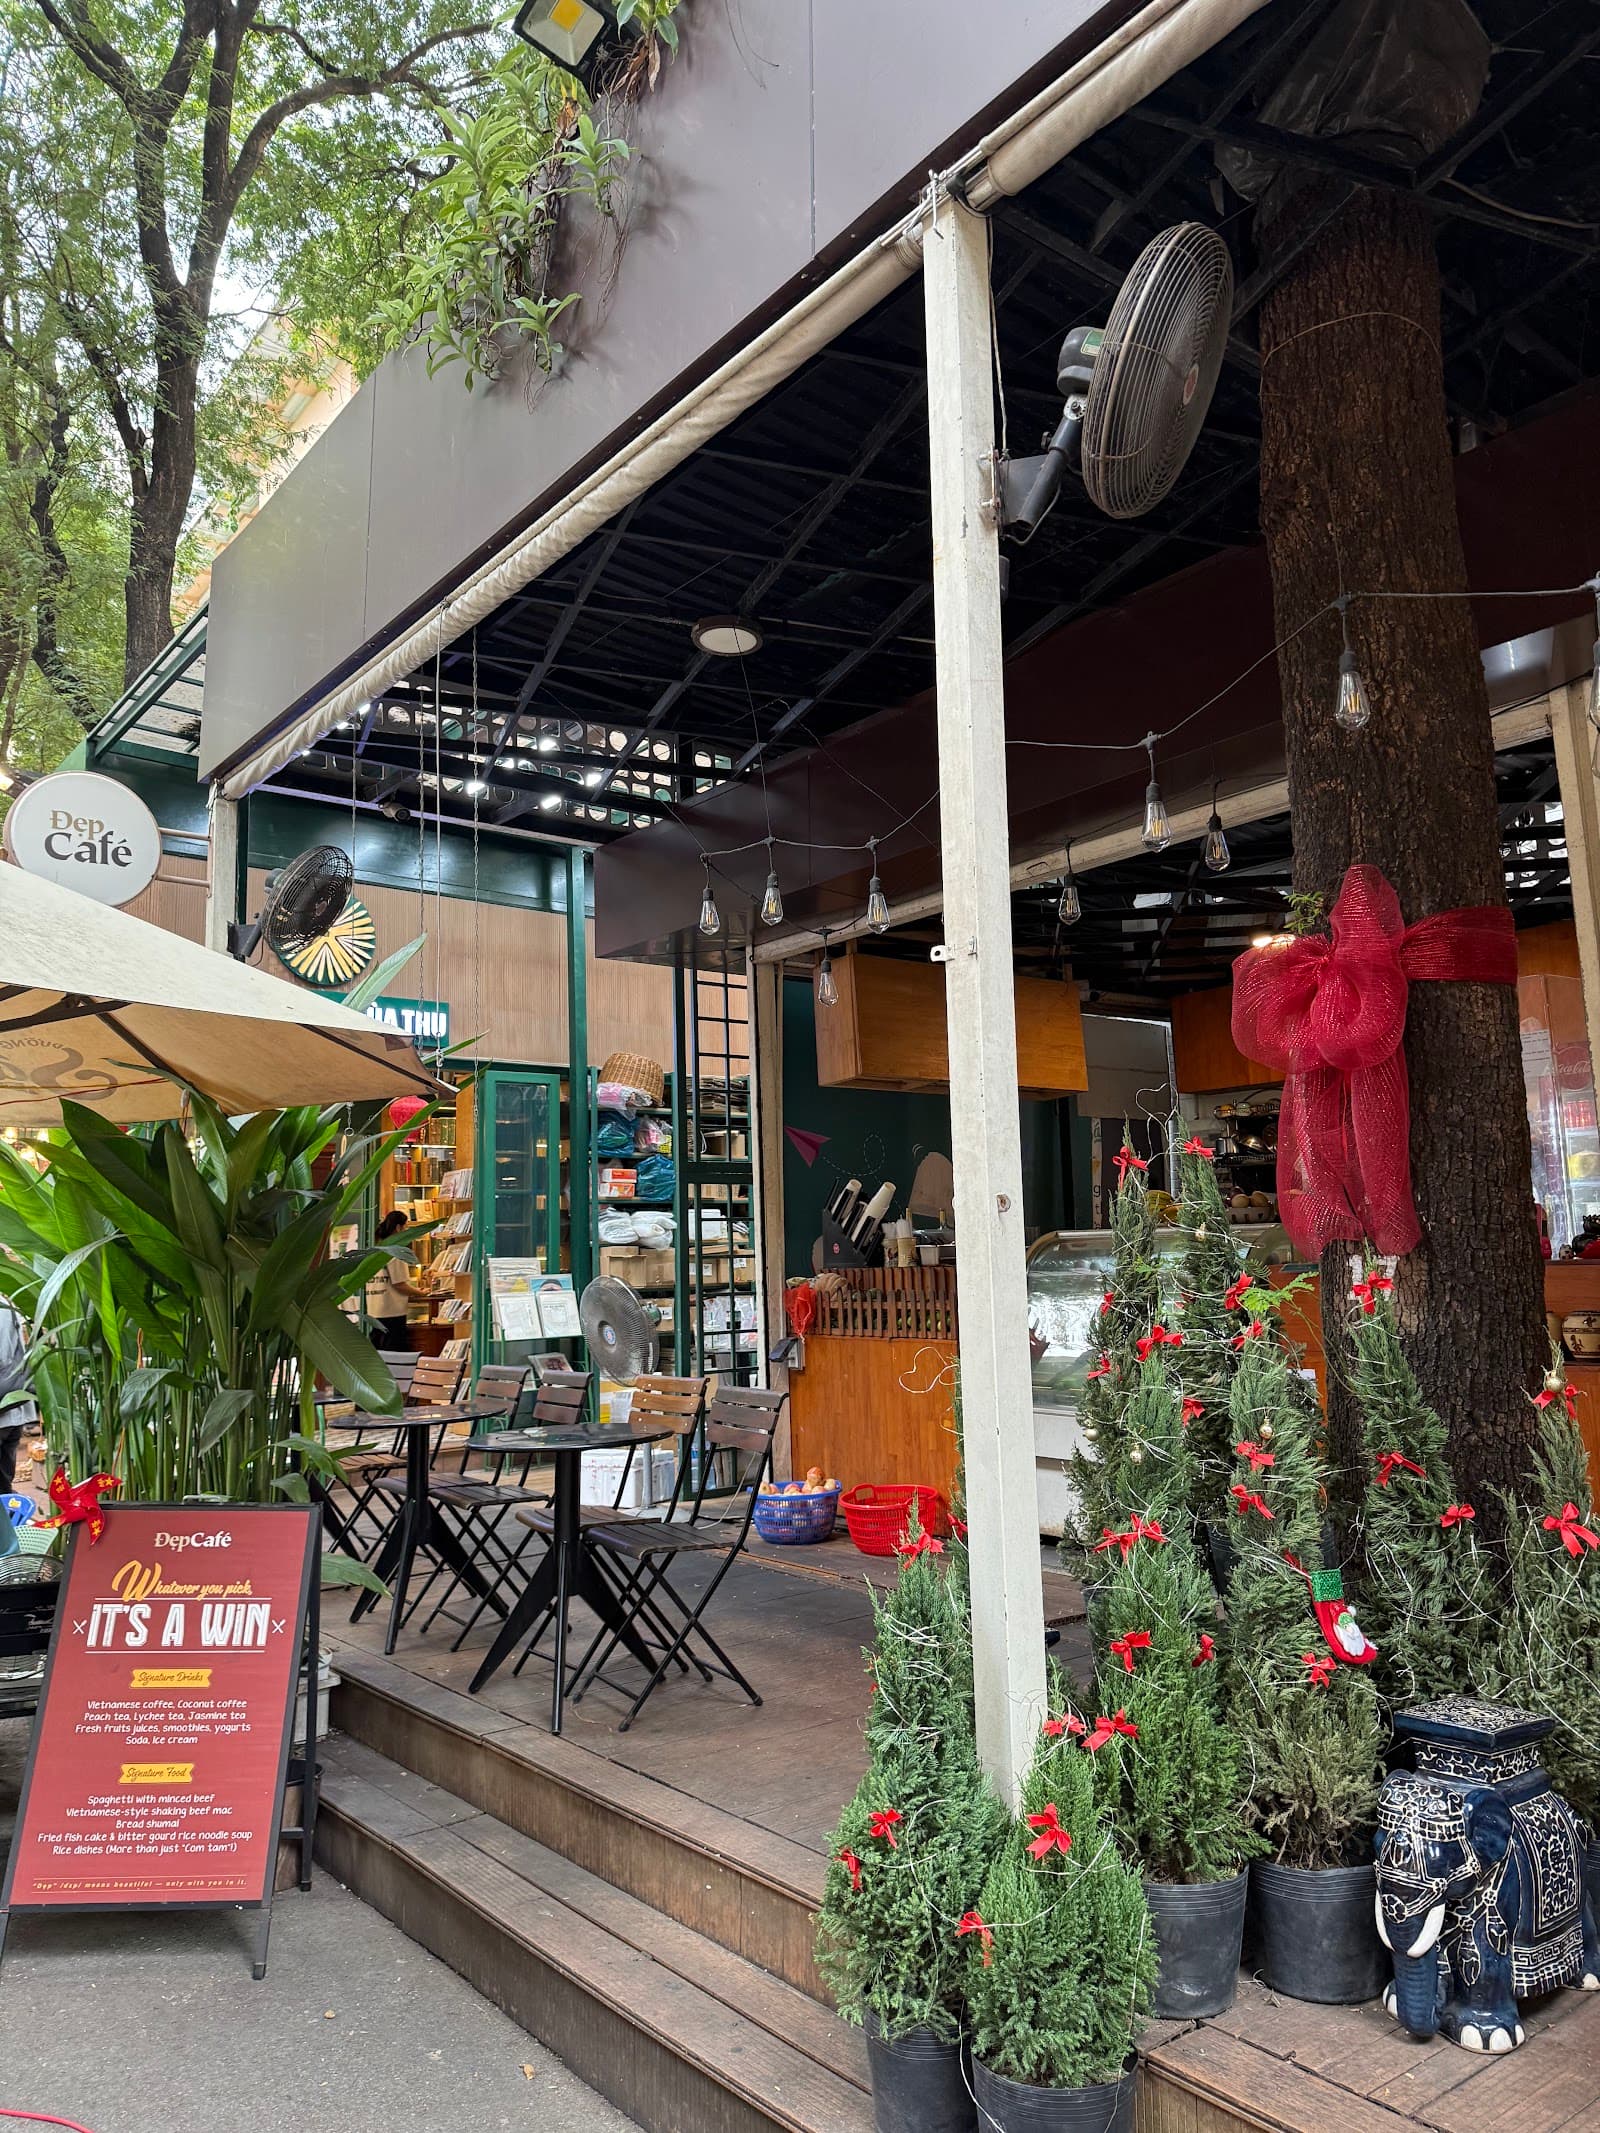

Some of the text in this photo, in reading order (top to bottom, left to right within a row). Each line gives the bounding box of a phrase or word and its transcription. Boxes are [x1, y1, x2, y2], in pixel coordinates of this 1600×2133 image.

[49, 809, 104, 840] Đẹp
[44, 831, 133, 867] Café
[401, 1008, 447, 1037] THU
[154, 1531, 232, 1552] ĐẹpCafé
[112, 1560, 199, 1601] Whatever
[198, 1583, 224, 1601] you
[86, 1603, 272, 1648] IT'S A WIN
[137, 1670, 204, 1686] Signature Drinks
[87, 1700, 141, 1710] Vietnamese
[177, 1699, 215, 1708] Coconut
[216, 1698, 248, 1708] coffee
[84, 1712, 112, 1721] Peach
[133, 1711, 165, 1723] Lychee
[188, 1711, 228, 1720] Jasmine
[230, 1711, 246, 1720] tea
[75, 1724, 102, 1733] Fresh
[104, 1723, 131, 1733] fruits
[214, 1722, 252, 1735] yogurts
[167, 1736, 199, 1744] cream
[126, 1766, 188, 1782] Signature Food
[87, 1793, 216, 1807] Spaghetti with minced beef
[66, 1805, 233, 1819] Vietnamese-style shaking beef mac
[116, 1818, 180, 1829] Bread shumai
[38, 1830, 253, 1844] Fried fish cake & bitter gourd rice noodle soup
[53, 1845, 72, 1855] Rice
[73, 1845, 104, 1855] dishes
[105, 1844, 133, 1855] (More
[135, 1843, 158, 1853] than
[158, 1842, 180, 1856] just
